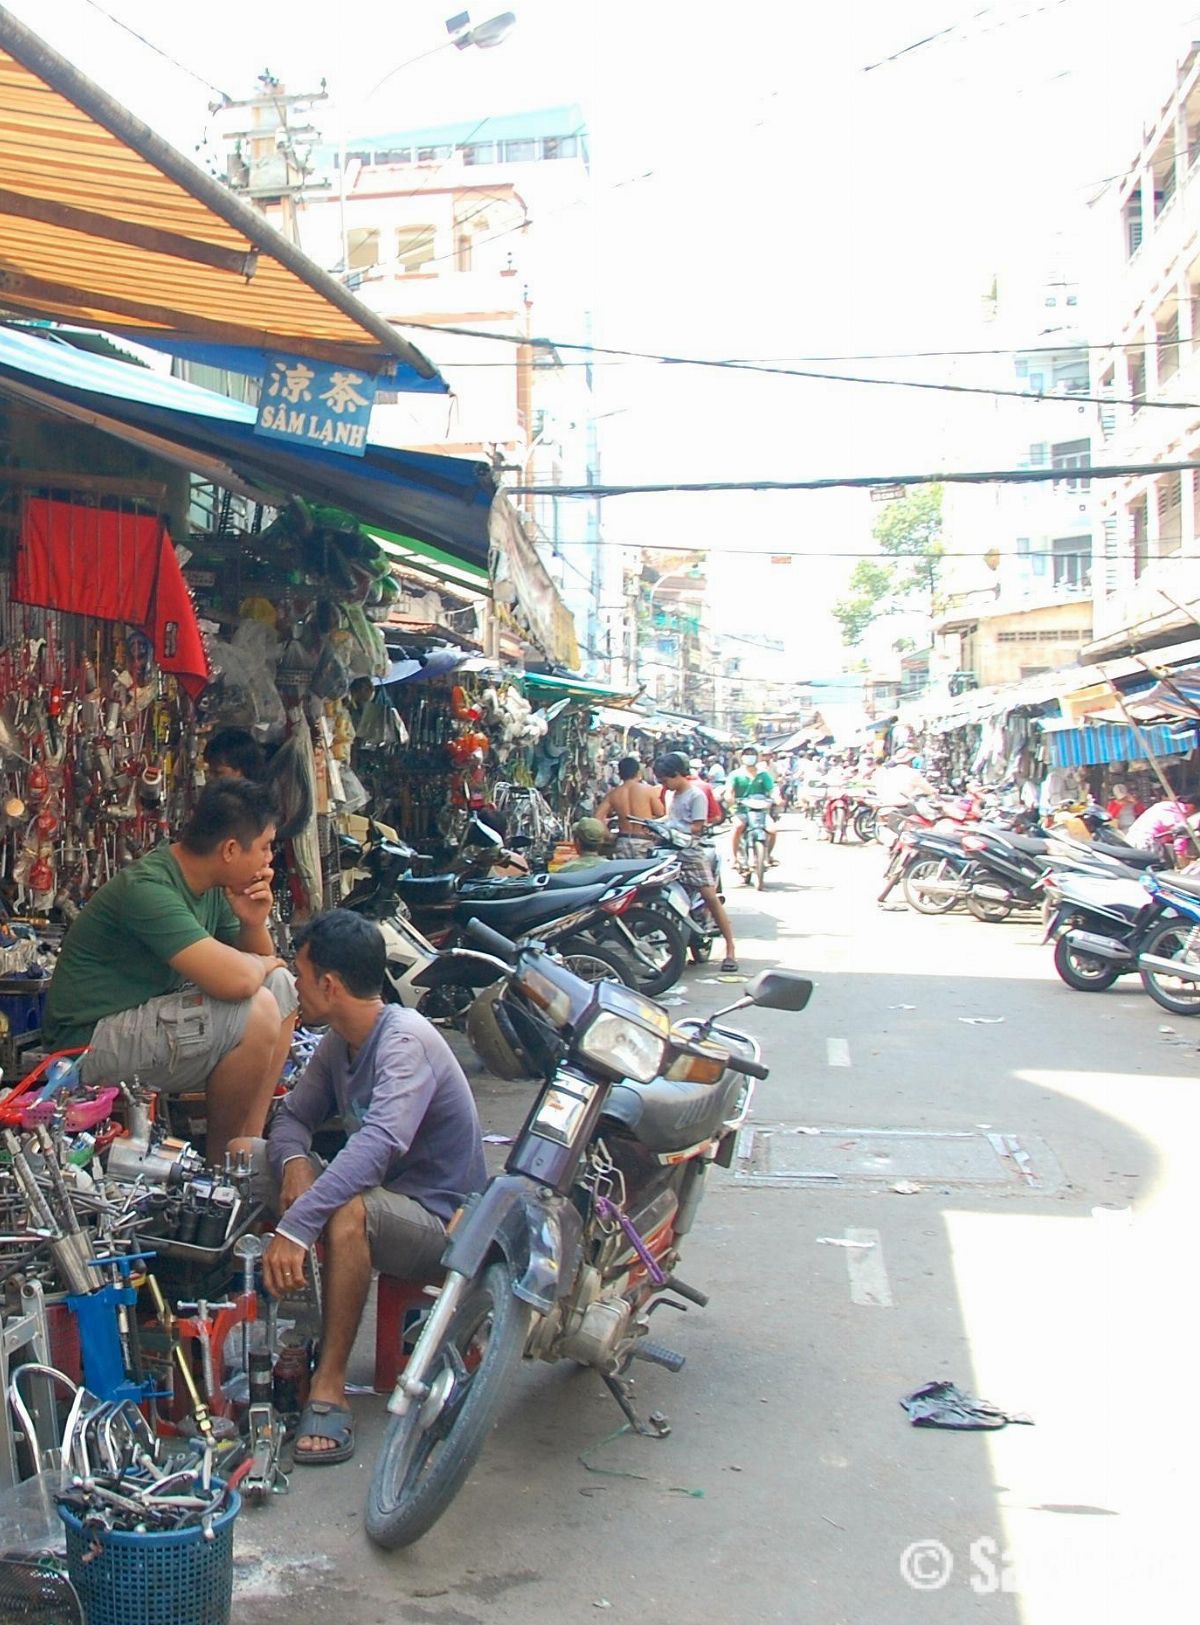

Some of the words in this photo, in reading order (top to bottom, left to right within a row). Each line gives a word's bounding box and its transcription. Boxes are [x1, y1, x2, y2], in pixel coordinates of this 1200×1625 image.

[268, 362, 370, 414] 涼茶
[260, 403, 306, 436] SÂM
[307, 415, 366, 447] LẠNH
